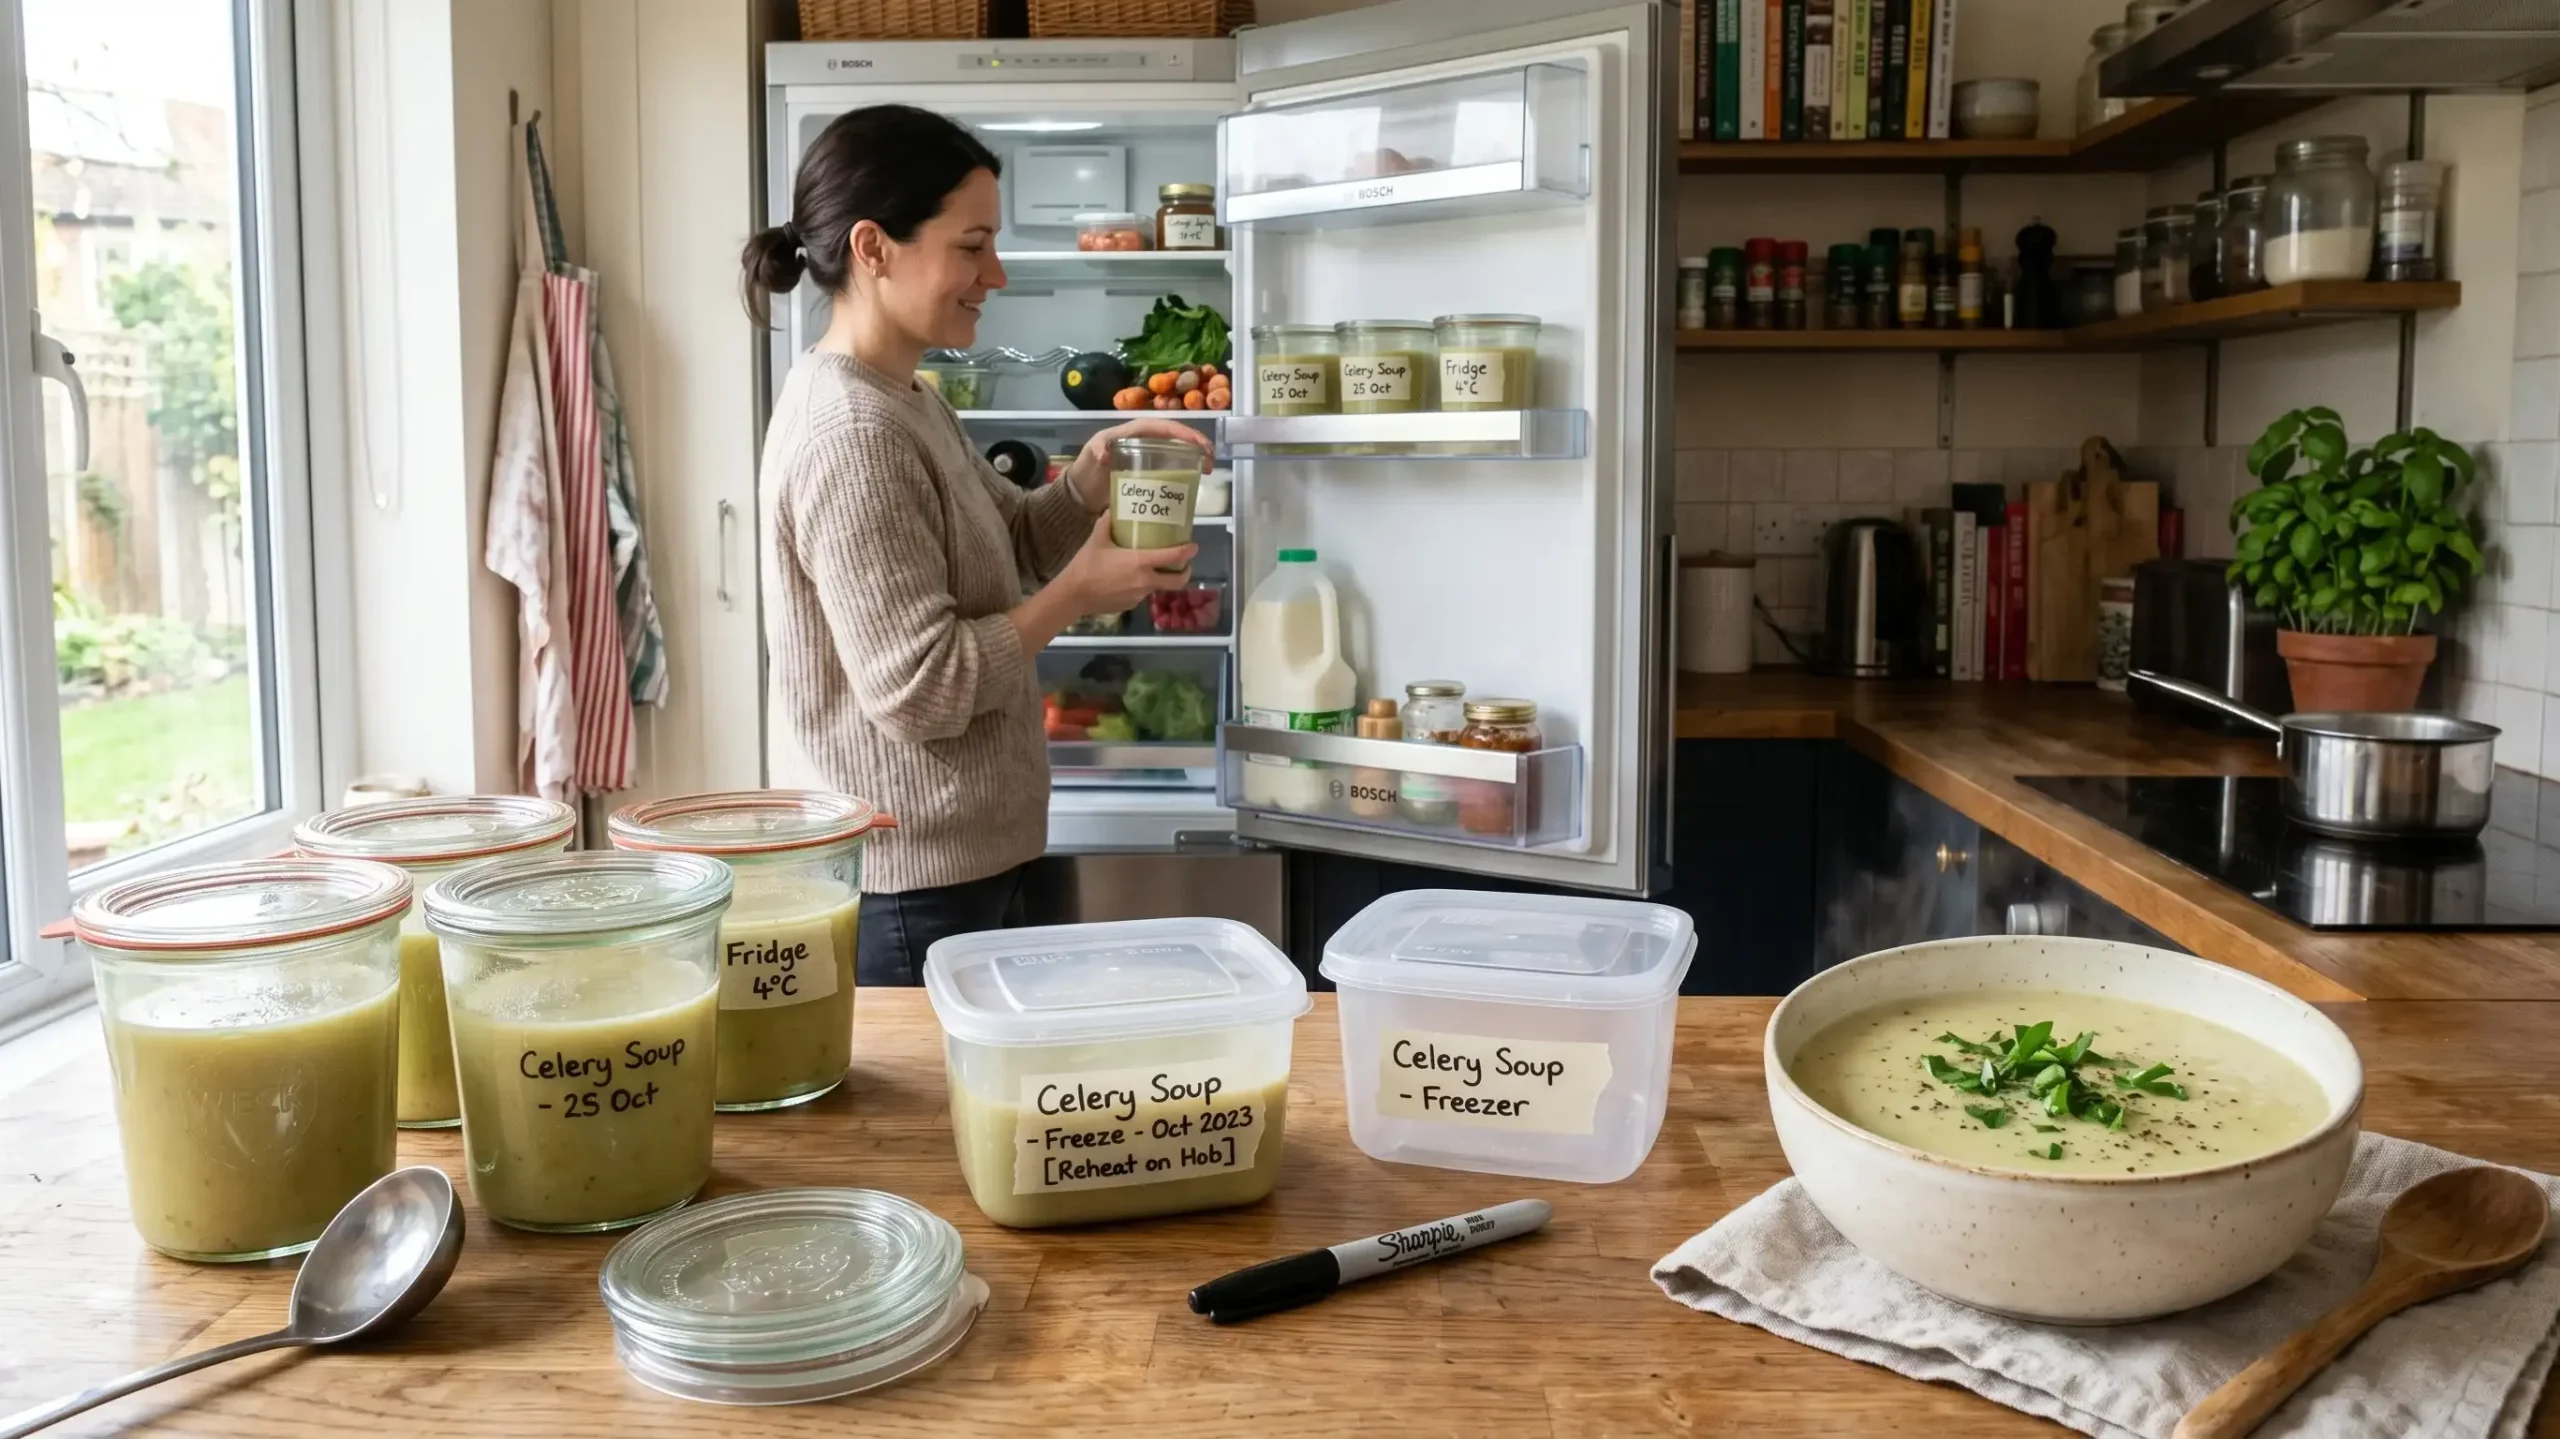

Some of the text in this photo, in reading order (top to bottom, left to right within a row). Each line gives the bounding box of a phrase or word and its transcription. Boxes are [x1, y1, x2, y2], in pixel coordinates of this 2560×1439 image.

[841, 60, 873, 69] BOSCH
[1358, 185, 1394, 199] BOSCH
[1262, 368, 1320, 386] Celery Soup
[1344, 362, 1407, 379] Celery Soup
[1445, 359, 1487, 377] Fridge
[1271, 387, 1309, 400] 25 Oct
[1353, 382, 1392, 395] 25 Oct
[1455, 380, 1479, 396] 4°C
[1121, 483, 1185, 505] Celery Soup
[1150, 503, 1171, 517] Oct
[1350, 784, 1397, 803] BOSCH
[726, 939, 810, 972] Fridge
[752, 973, 799, 1001] 4°C
[519, 1037, 686, 1088] Celery Soup
[1392, 1039, 1565, 1086] Celery Soup
[563, 1091, 601, 1119] 25
[610, 1081, 660, 1113] Oct
[1037, 1073, 1222, 1121] Celery Soup
[1422, 1085, 1530, 1118] Freezer
[1151, 1114, 1194, 1139] Oct
[1199, 1104, 1254, 1134] 2023
[1043, 1136, 1236, 1186] [Reheat on Hob]
[1377, 1221, 1462, 1263] Sharpie
